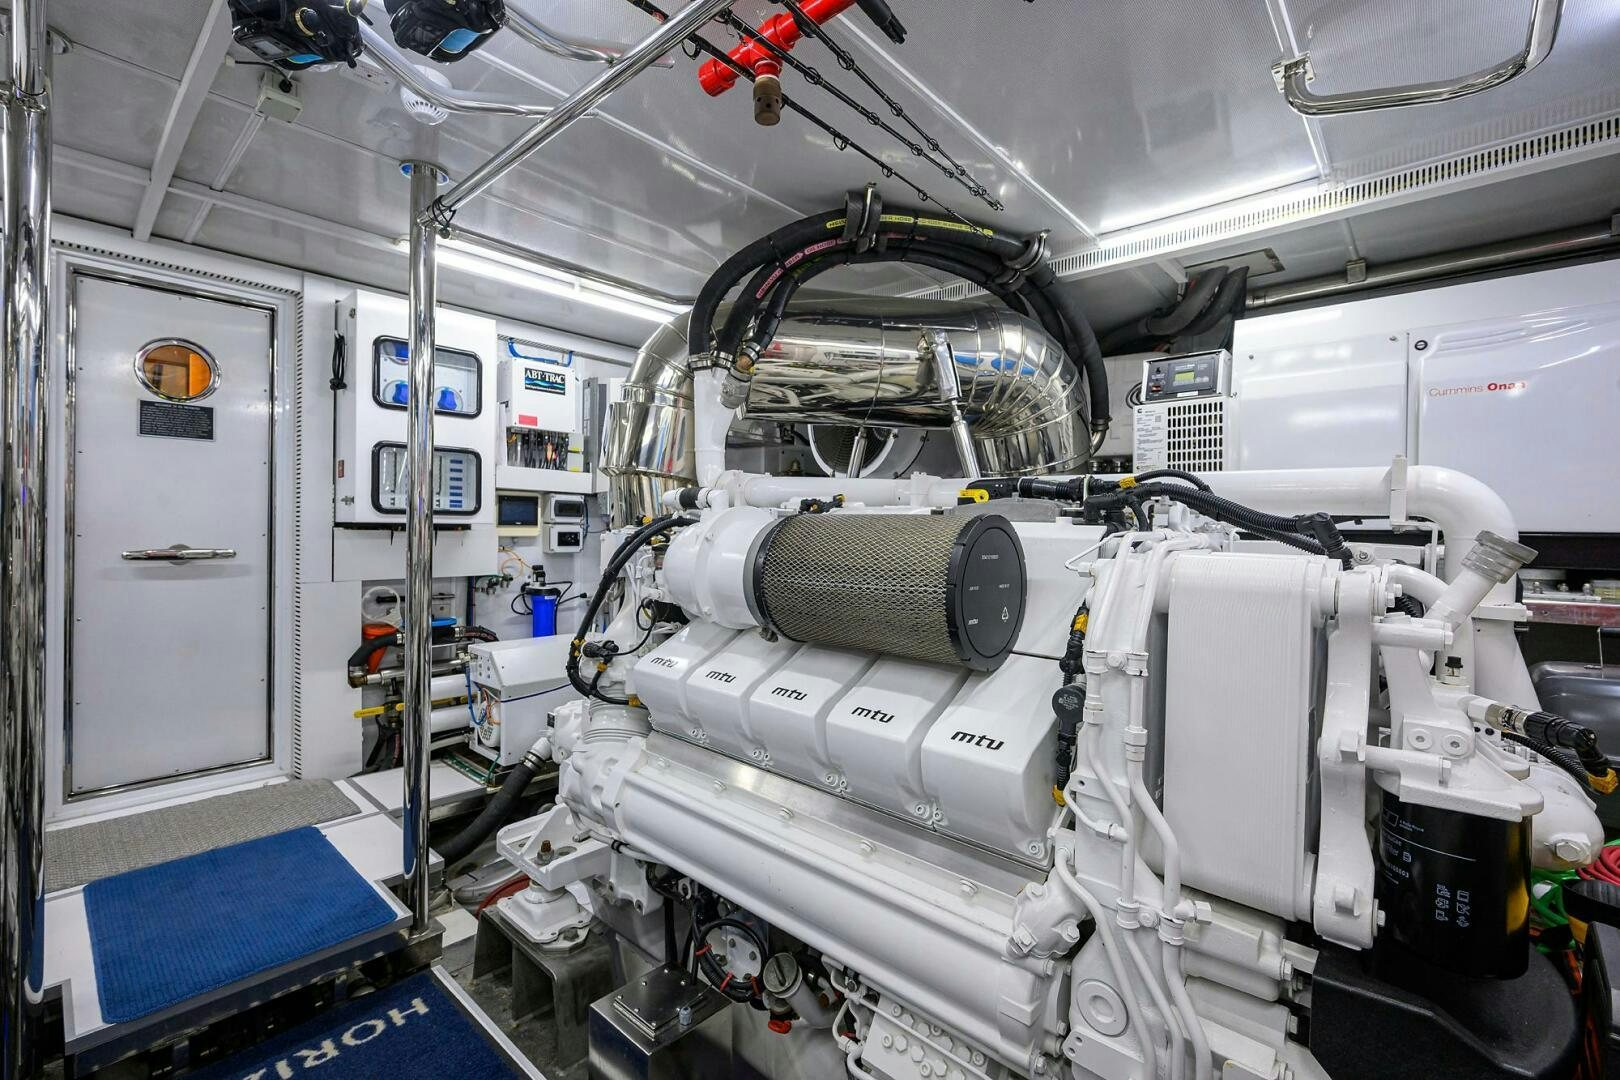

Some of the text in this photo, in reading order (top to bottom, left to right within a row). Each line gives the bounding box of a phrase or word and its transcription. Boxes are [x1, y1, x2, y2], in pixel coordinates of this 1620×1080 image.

[1428, 385, 1484, 397] Cummins
[650, 657, 679, 668] mtu
[705, 670, 737, 684] mtu
[771, 686, 808, 701] mtu
[851, 706, 895, 724] mtu
[950, 730, 1005, 751] mtu
[243, 997, 430, 1080] HORI
